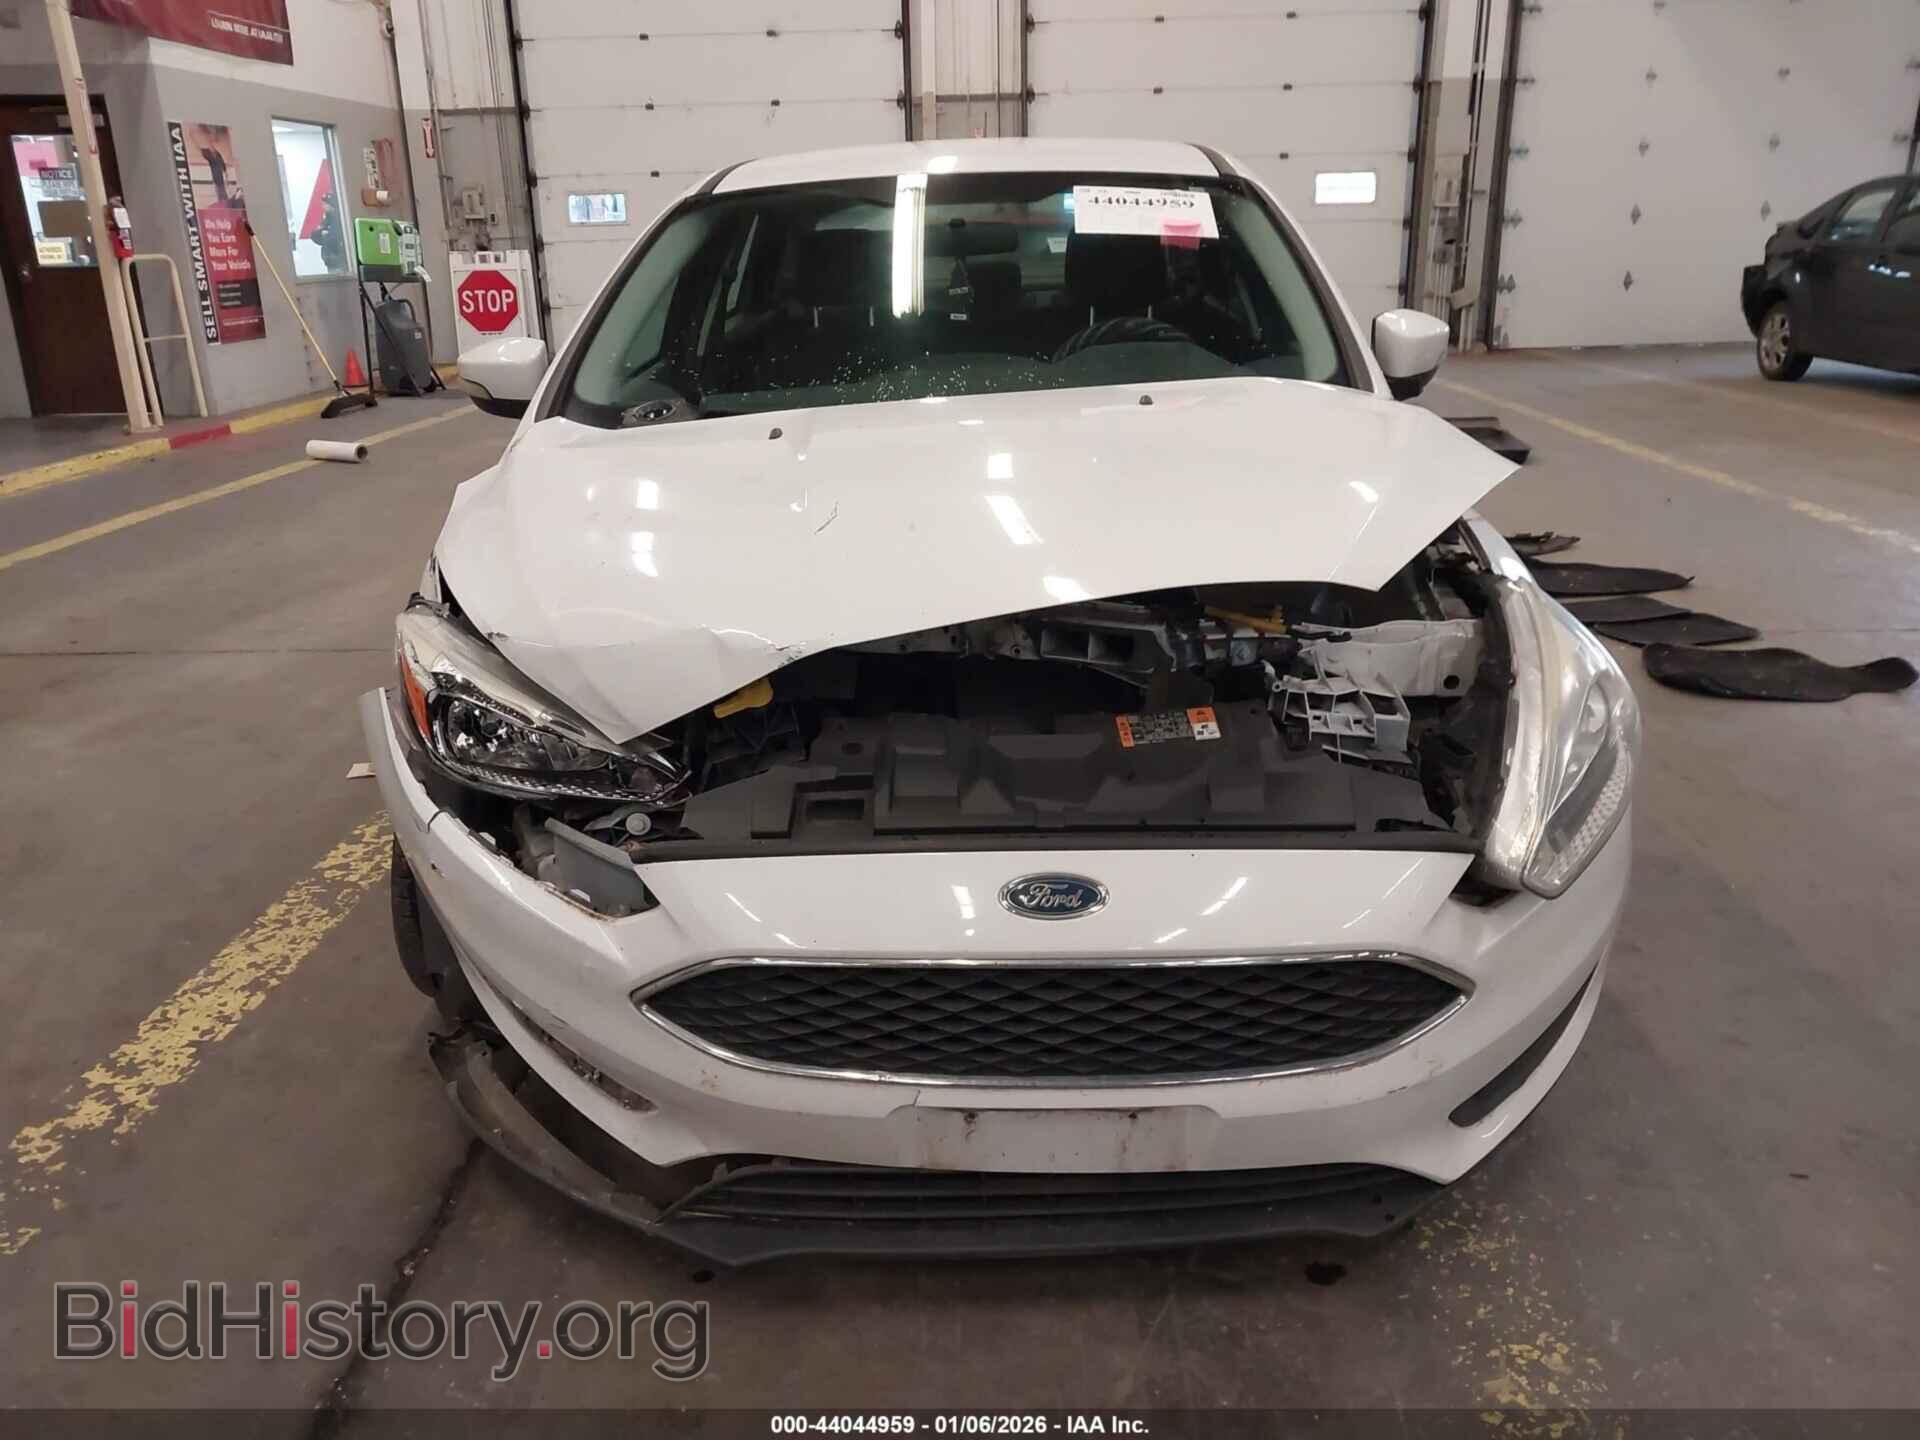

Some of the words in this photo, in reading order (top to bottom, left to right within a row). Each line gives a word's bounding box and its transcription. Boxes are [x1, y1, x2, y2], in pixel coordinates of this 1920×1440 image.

[171, 127, 186, 161] IAA
[177, 167, 195, 219] WITH
[188, 224, 209, 291] SMART
[201, 298, 217, 339] SELL
[461, 288, 515, 314] STOP
[1019, 883, 1083, 908] Ford
